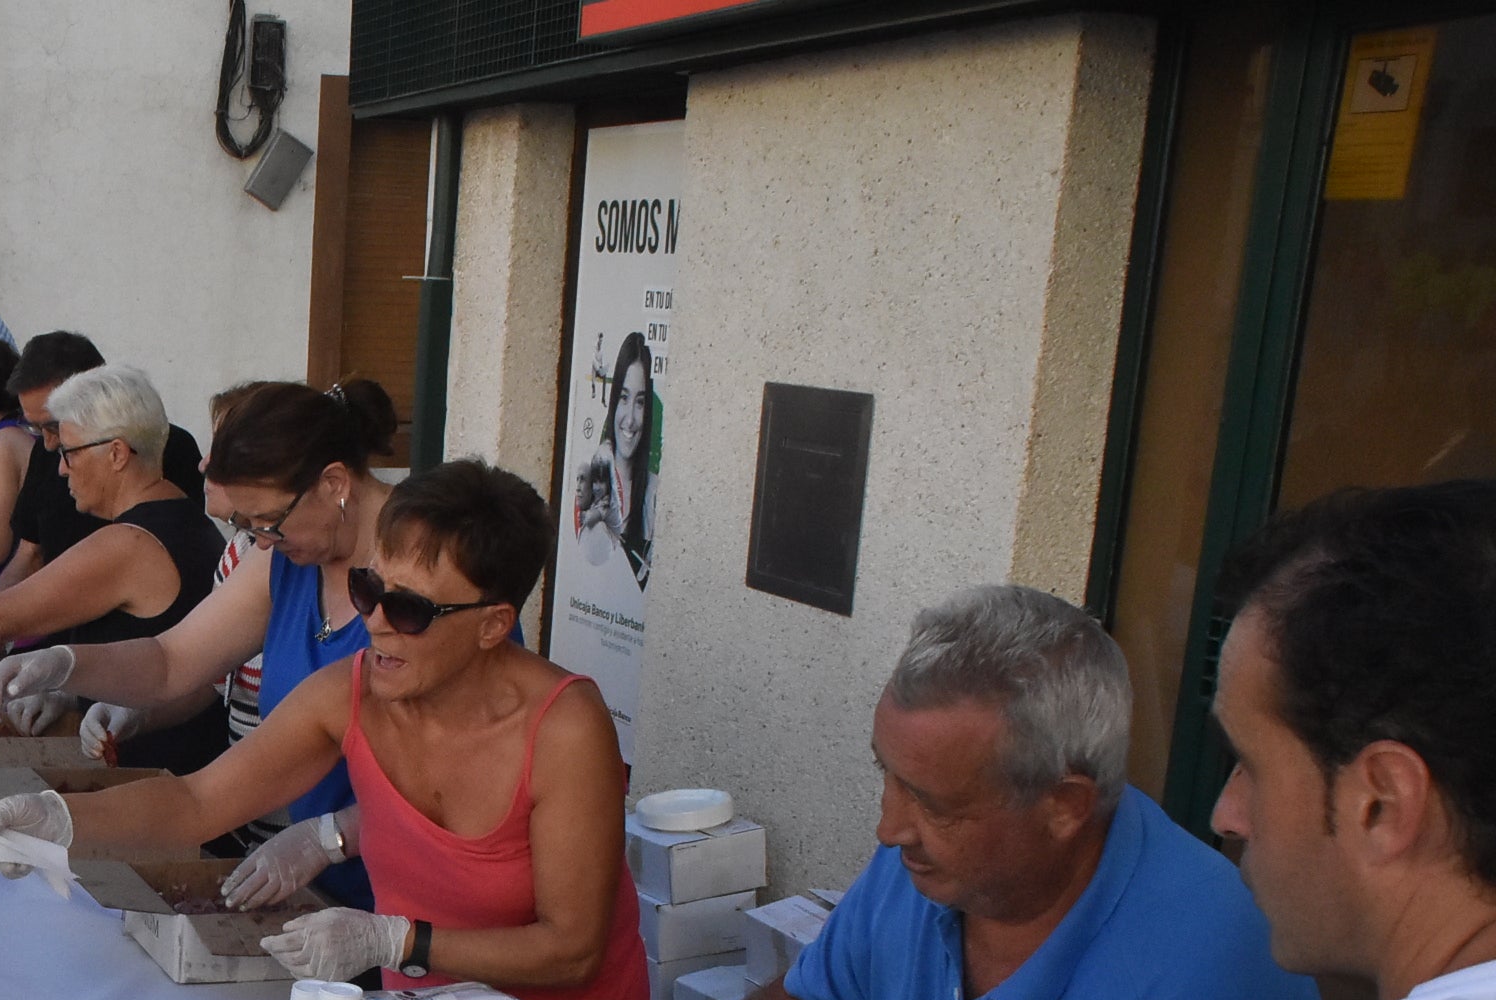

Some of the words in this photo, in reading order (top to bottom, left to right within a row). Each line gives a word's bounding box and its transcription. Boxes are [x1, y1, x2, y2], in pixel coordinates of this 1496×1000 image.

[595, 198, 662, 254] SOMOS
[645, 290, 655, 308] EN
[656, 291, 664, 309] TU
[648, 323, 657, 341] EN
[659, 324, 667, 342] TU
[654, 356, 663, 374] EN
[570, 596, 591, 615] Unicaja
[592, 603, 609, 620] Banco
